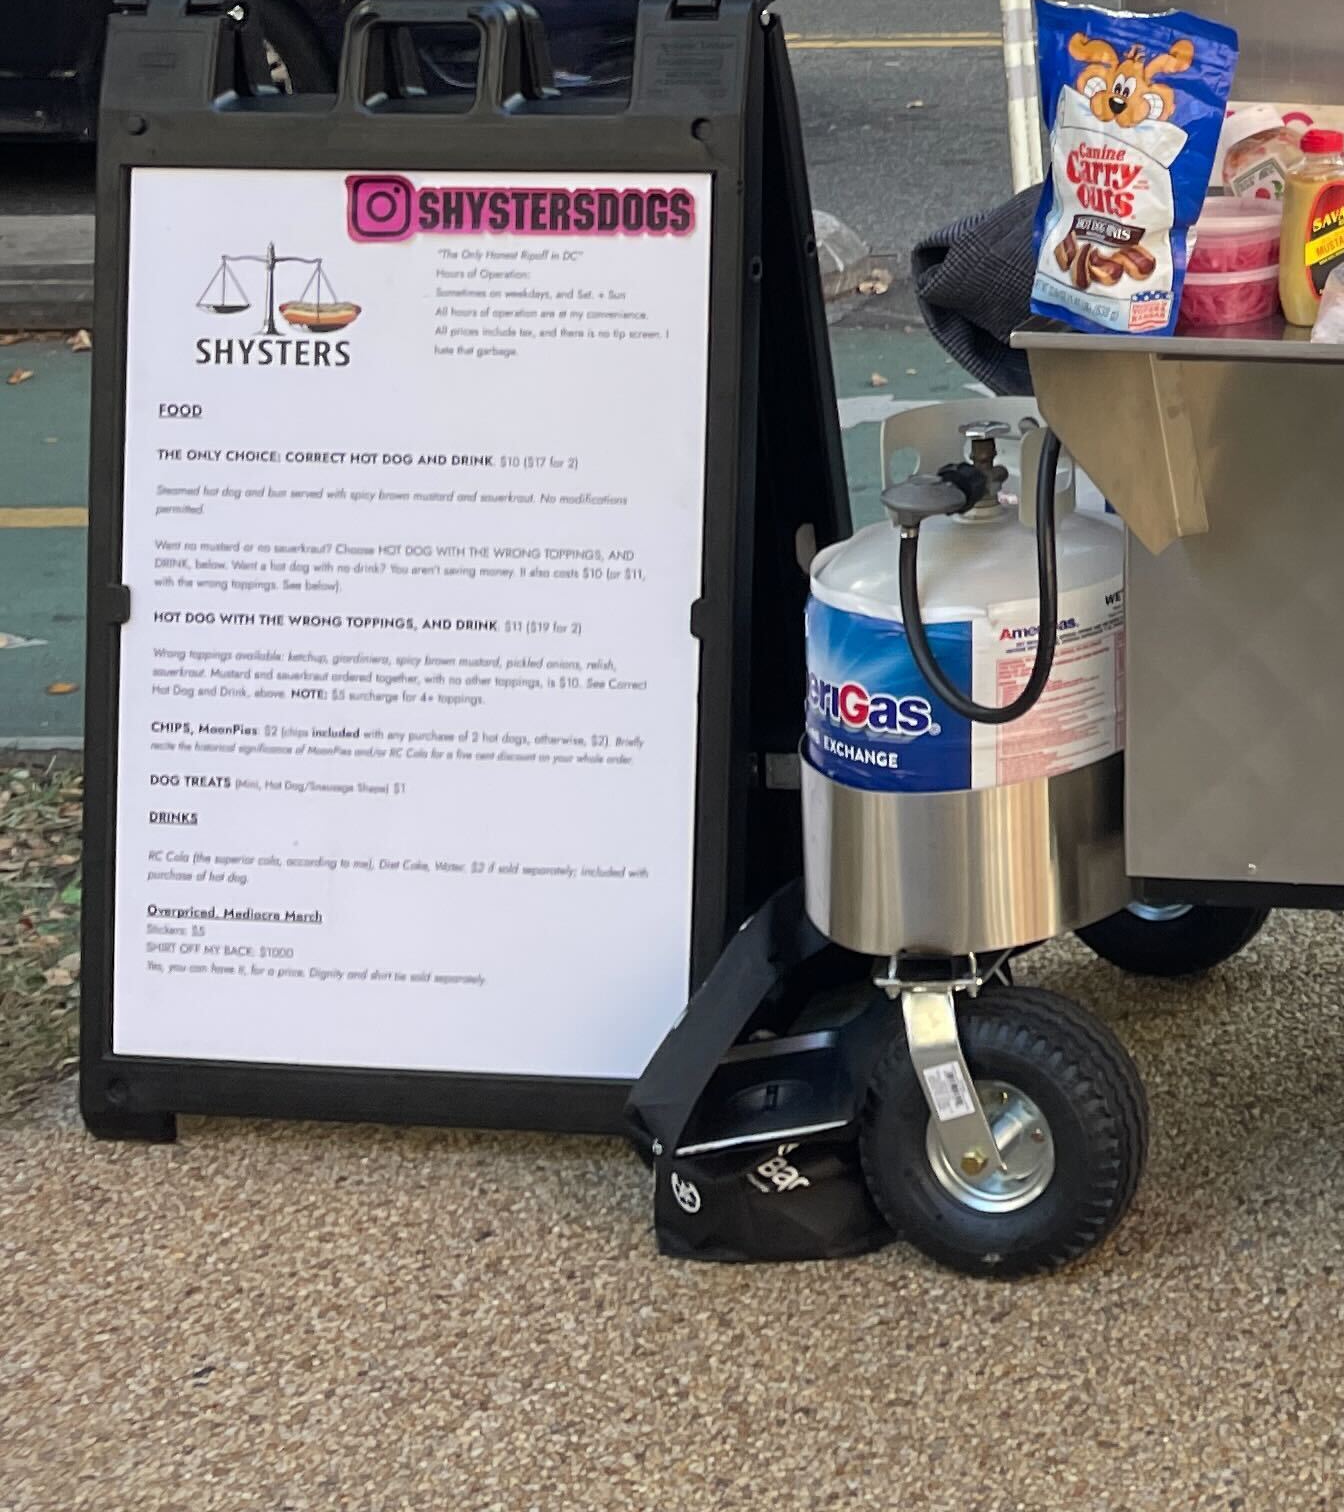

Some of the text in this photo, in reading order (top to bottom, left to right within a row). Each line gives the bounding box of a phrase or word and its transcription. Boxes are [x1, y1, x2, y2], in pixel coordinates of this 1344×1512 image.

[1079, 142, 1126, 161] Canine
[1066, 148, 1143, 190] Carry
[418, 191, 693, 233] SHYSTERSDOGS
[195, 336, 352, 368] SHYSTERS
[157, 404, 204, 419] FOOD
[155, 449, 183, 460] THE
[185, 449, 223, 461] ONLY
[284, 452, 348, 464] CORRECT
[349, 452, 380, 465] HOT
[381, 453, 414, 465] DOG
[416, 455, 448, 465] AND
[499, 455, 521, 469] $10
[522, 456, 547, 470] ($17
[548, 455, 565, 468] for
[567, 456, 579, 470] 2)
[153, 611, 183, 623] HOT
[184, 612, 216, 624] DOG
[218, 612, 256, 625] WITH
[258, 614, 285, 626] THE
[287, 615, 343, 628] WRONG
[345, 617, 419, 631] TOPPINGS,
[421, 619, 453, 630] AND
[504, 620, 523, 633] $11
[525, 620, 551, 635] ($19
[552, 621, 568, 634] for
[570, 622, 582, 636] 2)
[999, 617, 1078, 641] Ameas
[806, 671, 933, 736] eriGas
[823, 735, 899, 769] EXCHANGE
[148, 811, 199, 825] DRINKS
[222, 907, 281, 922] Mediocre
[283, 909, 323, 924] Merch
[757, 1156, 811, 1193] Bar
